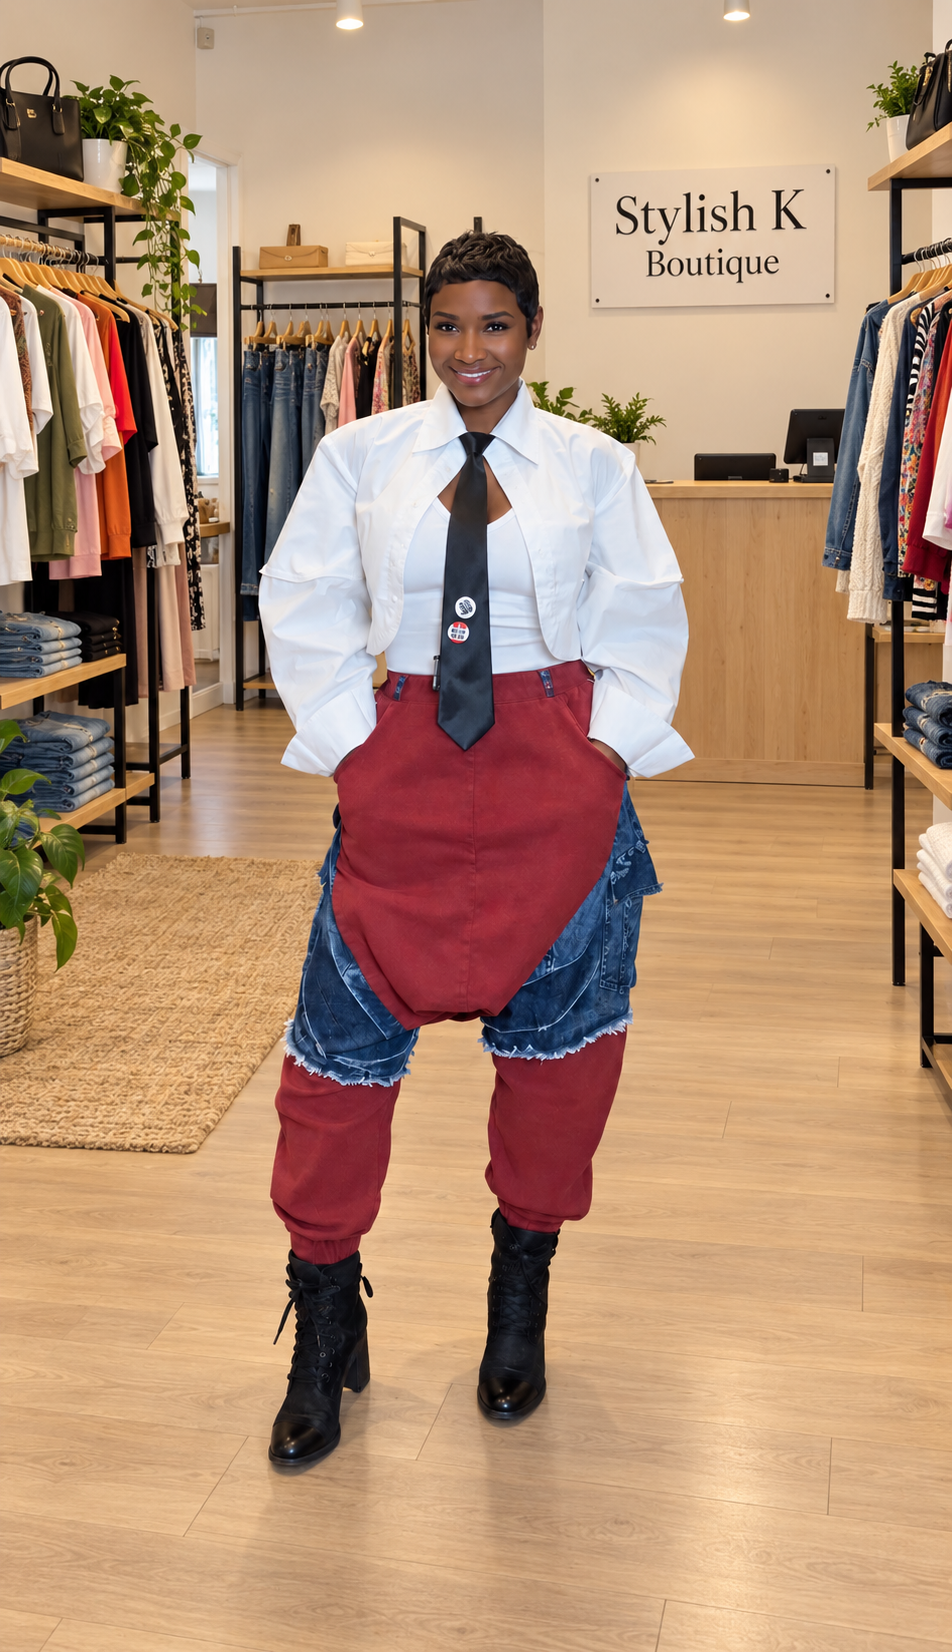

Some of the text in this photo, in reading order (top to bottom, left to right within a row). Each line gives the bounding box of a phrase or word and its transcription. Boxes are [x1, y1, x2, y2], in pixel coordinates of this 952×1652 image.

[615, 188, 807, 246] Stylish K
[646, 248, 780, 284] Boutique
